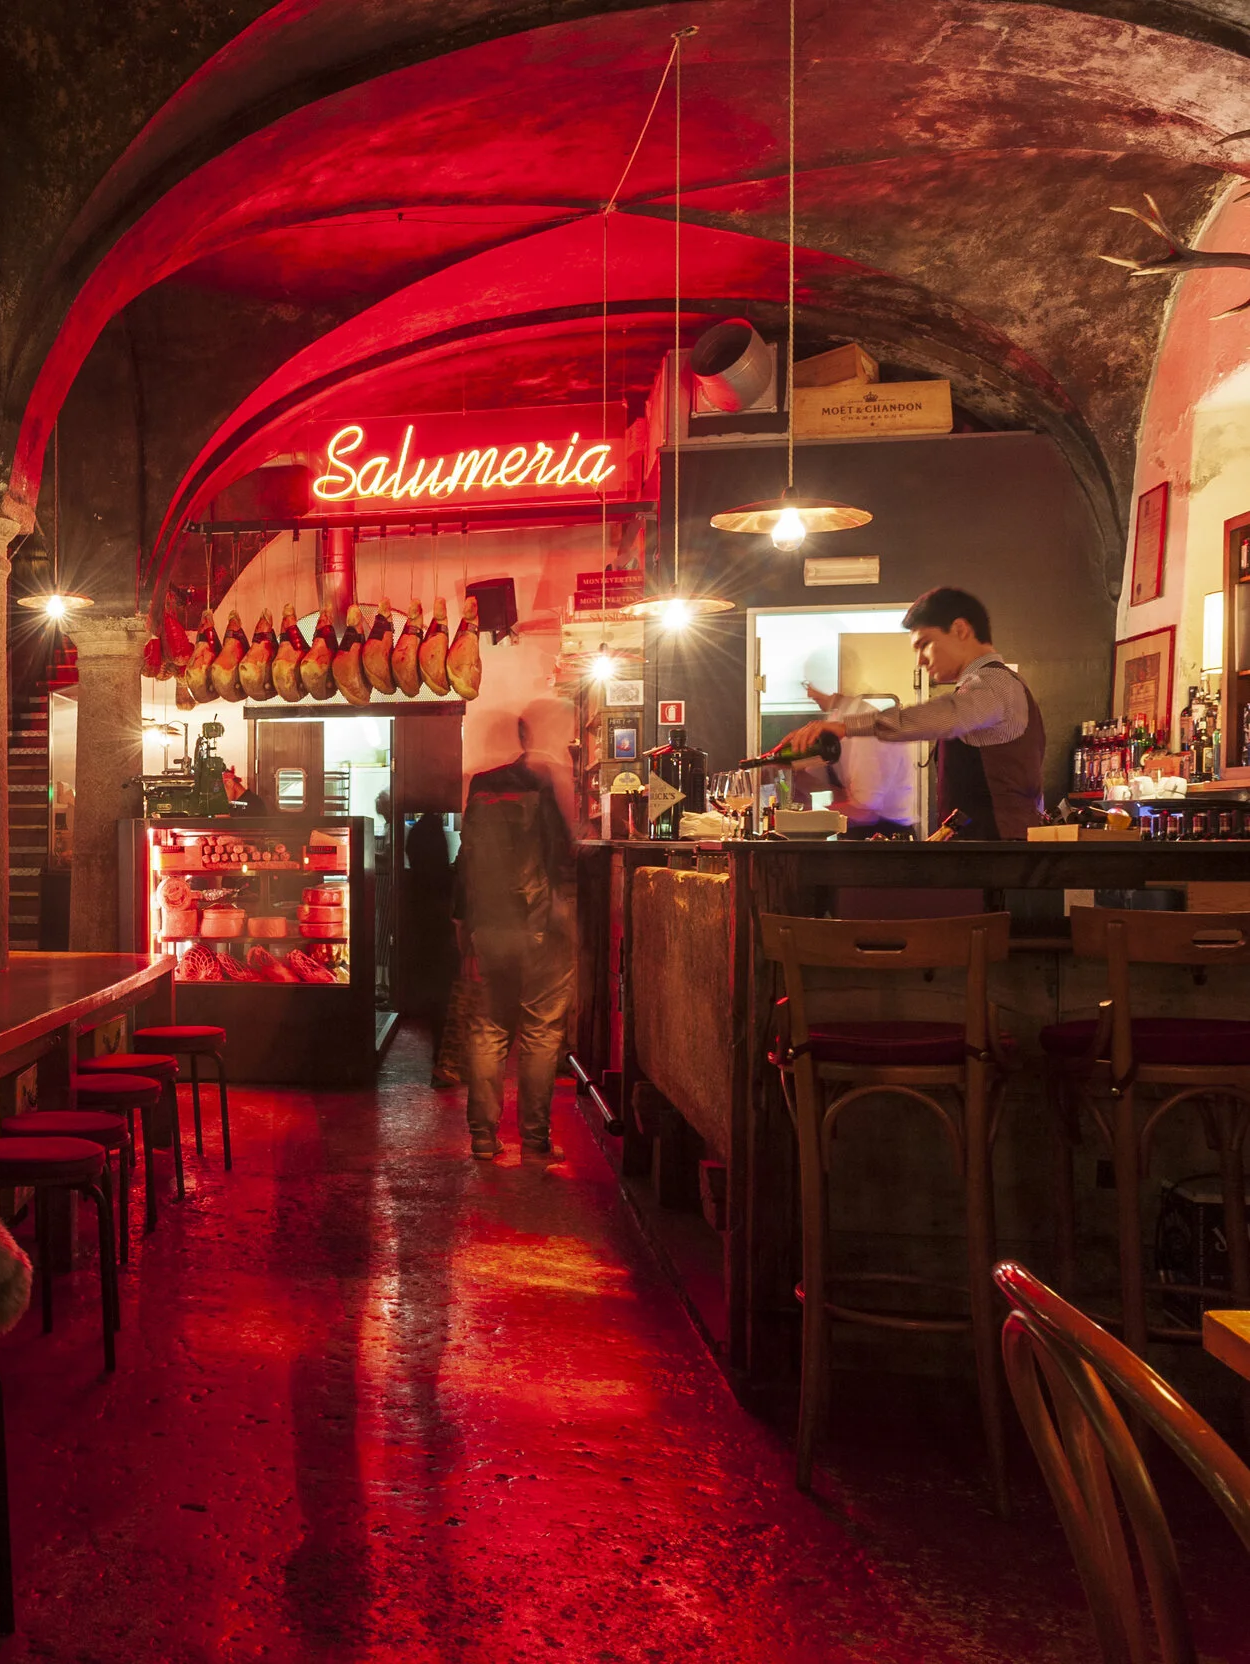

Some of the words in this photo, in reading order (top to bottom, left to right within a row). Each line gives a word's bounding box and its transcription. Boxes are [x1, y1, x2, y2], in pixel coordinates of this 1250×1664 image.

[821, 405, 853, 416] MOËT
[864, 402, 922, 413] CHANDON
[840, 413, 903, 421] CHAMPAGNE
[313, 425, 616, 499] Salumeria
